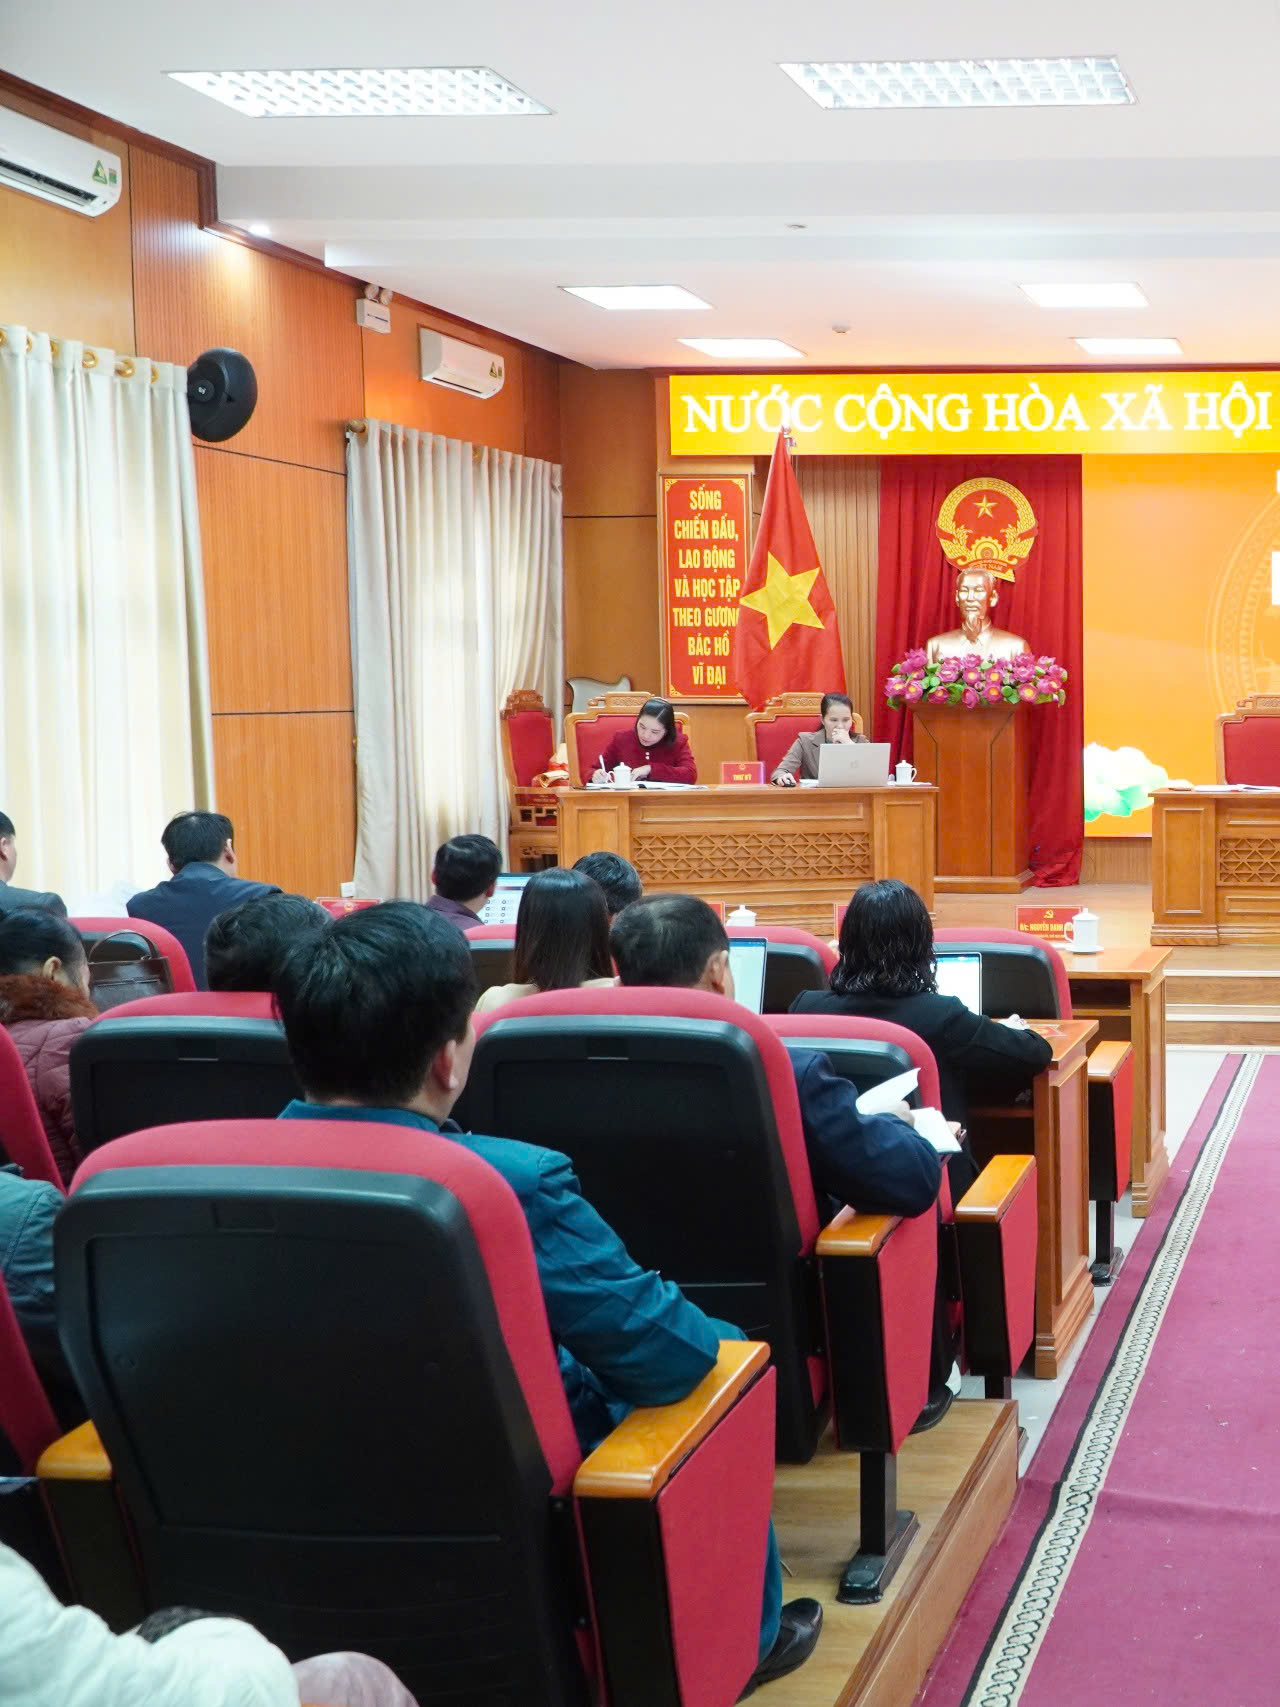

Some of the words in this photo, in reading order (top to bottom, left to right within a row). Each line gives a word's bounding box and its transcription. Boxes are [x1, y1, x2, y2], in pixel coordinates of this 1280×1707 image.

[681, 384, 823, 433] NƯỚC
[834, 384, 972, 439] CỘNG
[983, 382, 1089, 432] HÒA
[1101, 384, 1173, 431] XÃ
[1184, 381, 1273, 438] HỘI
[689, 484, 722, 510] SỐNG
[674, 513, 709, 539] CHIẾN
[711, 513, 739, 541] ĐẤU,
[678, 549, 701, 569] LAO
[703, 545, 736, 572] ĐỘNG
[674, 574, 690, 598] VÀ
[692, 578, 716, 602] HỌC
[718, 574, 741, 602] TẬP
[672, 607, 702, 627] THEO
[688, 632, 711, 656] BÁC
[714, 630, 730, 656] HỒ
[692, 662, 704, 685] VĨ
[706, 665, 726, 689] ĐẠI
